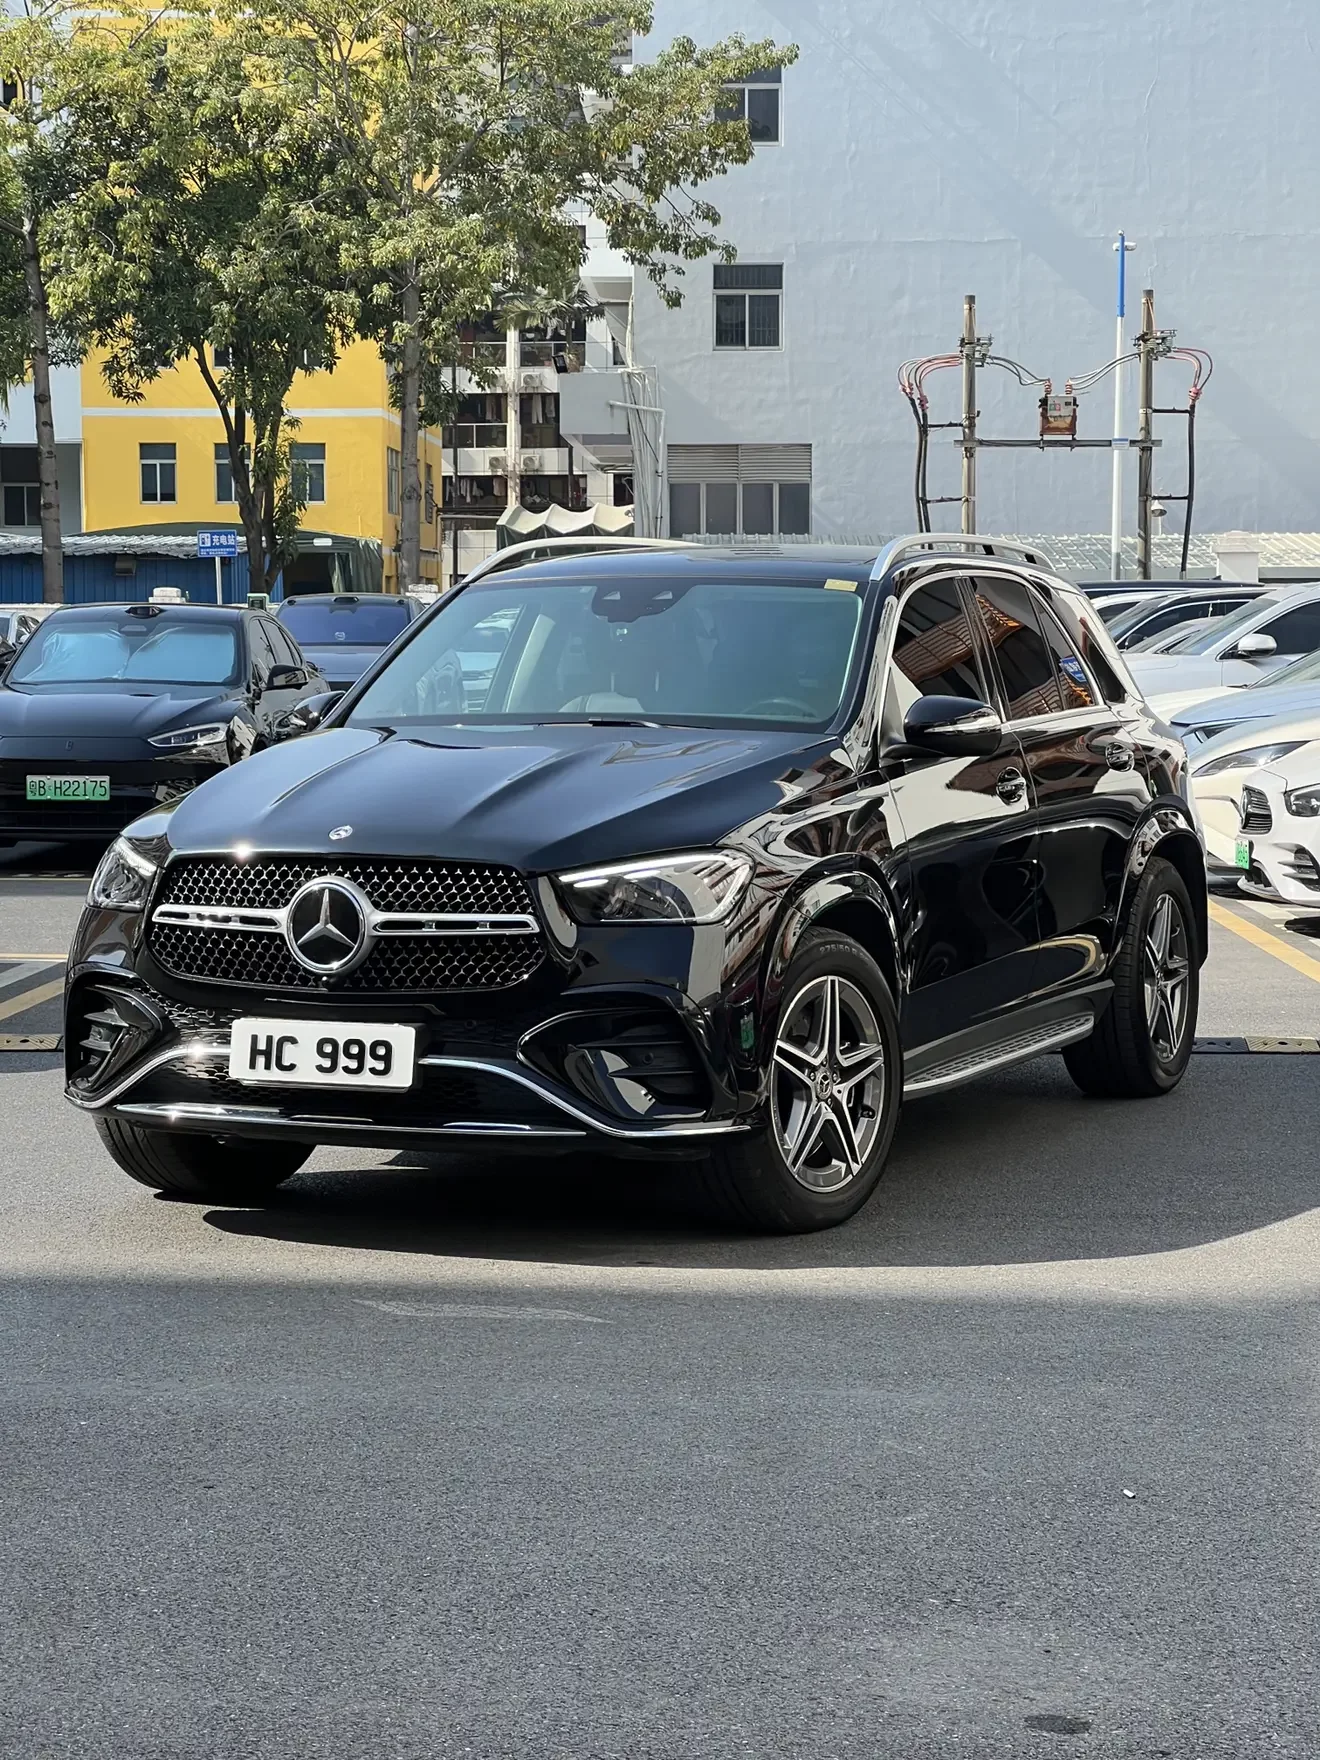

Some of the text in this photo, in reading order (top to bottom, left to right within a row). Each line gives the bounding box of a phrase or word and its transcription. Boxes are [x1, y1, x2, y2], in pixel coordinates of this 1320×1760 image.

[212, 534, 235, 546] 充电站
[248, 1034, 393, 1076] HC 999
